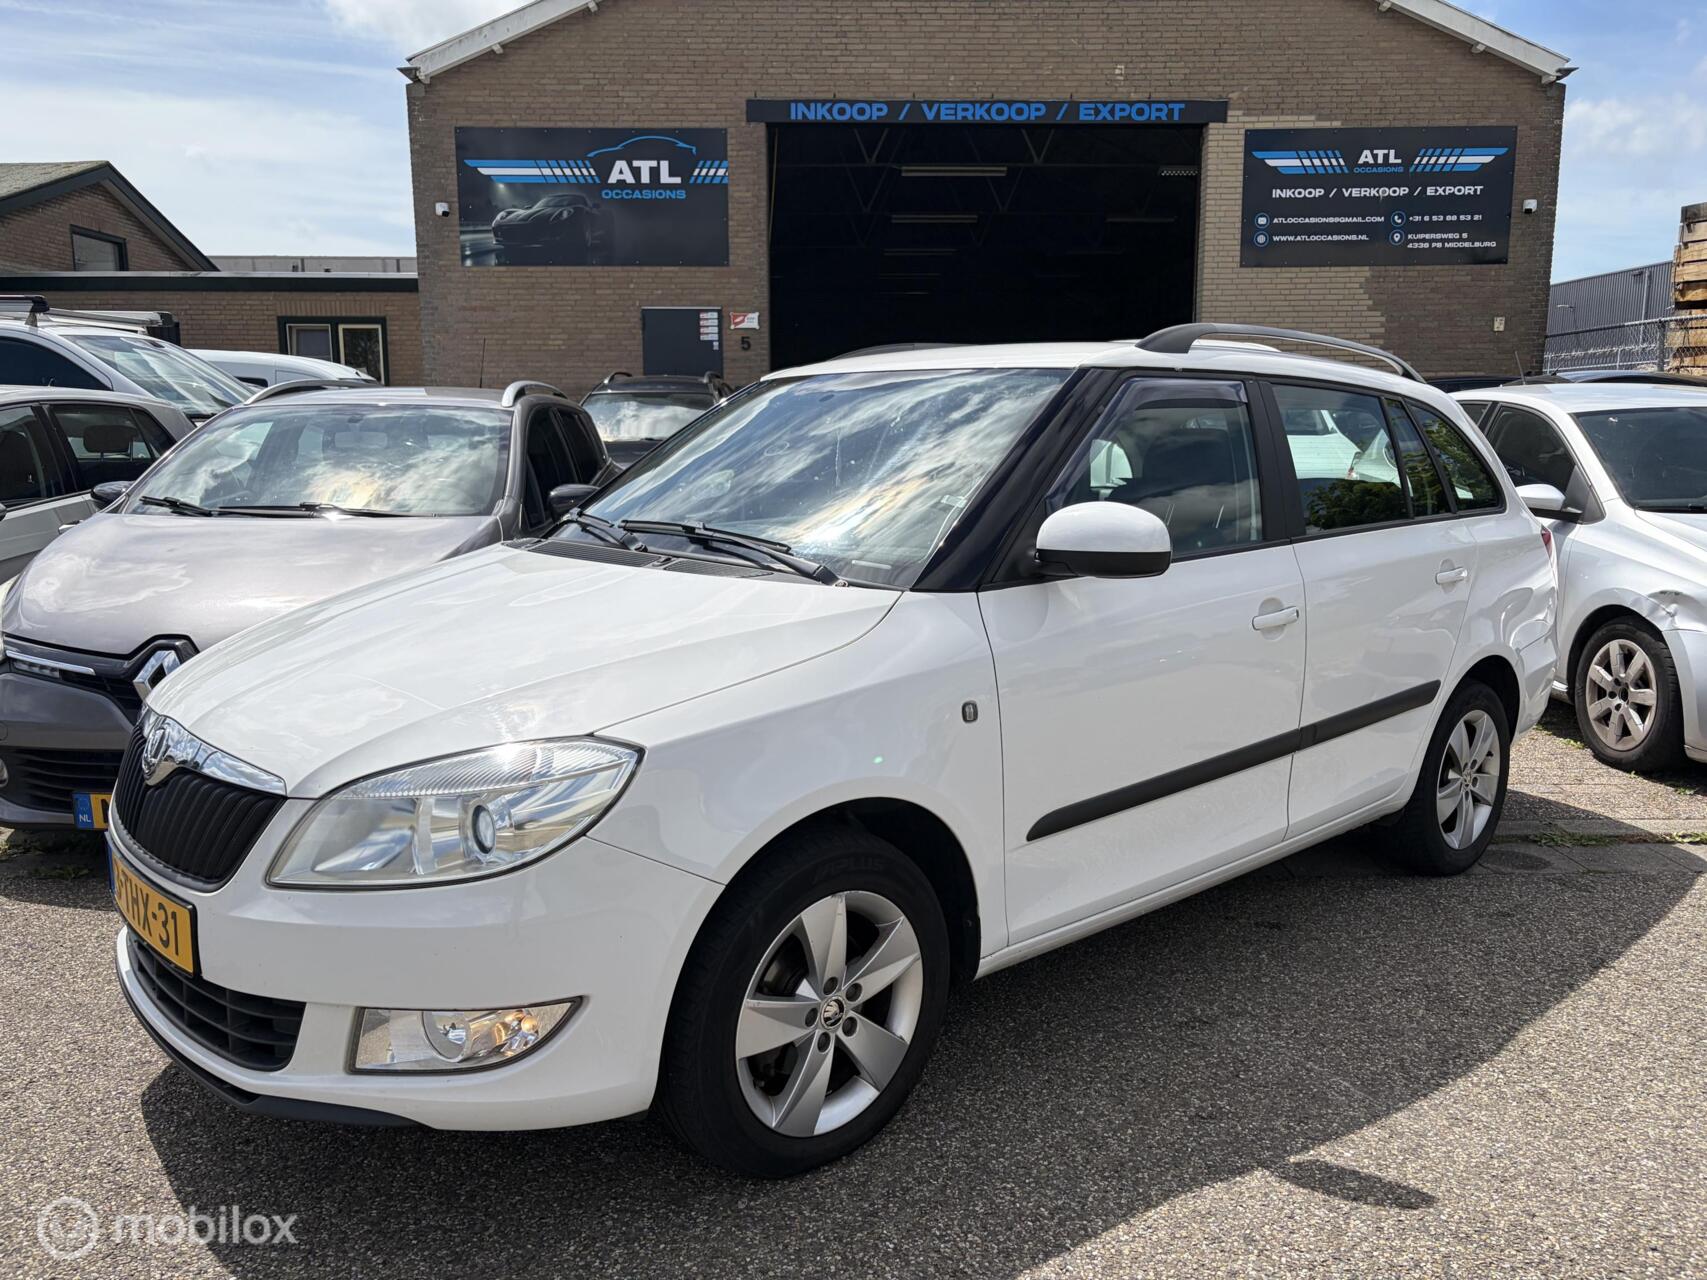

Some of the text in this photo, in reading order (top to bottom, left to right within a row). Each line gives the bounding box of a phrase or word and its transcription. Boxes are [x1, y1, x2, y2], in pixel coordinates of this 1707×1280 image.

[790, 102, 1186, 121] INKOOP / VERKOOP / EXPORT
[1357, 149, 1402, 164] ATL
[608, 160, 682, 184] ATL
[1353, 166, 1404, 174] OCCASIONS
[601, 189, 686, 199] OCCASIONS
[1272, 186, 1484, 198] INKOOP / VERKOOP / EXPORT
[1272, 234, 1369, 242] WWW.ATLOCCASIONS.NL
[741, 336, 751, 350] 5
[79, 813, 92, 823] NL
